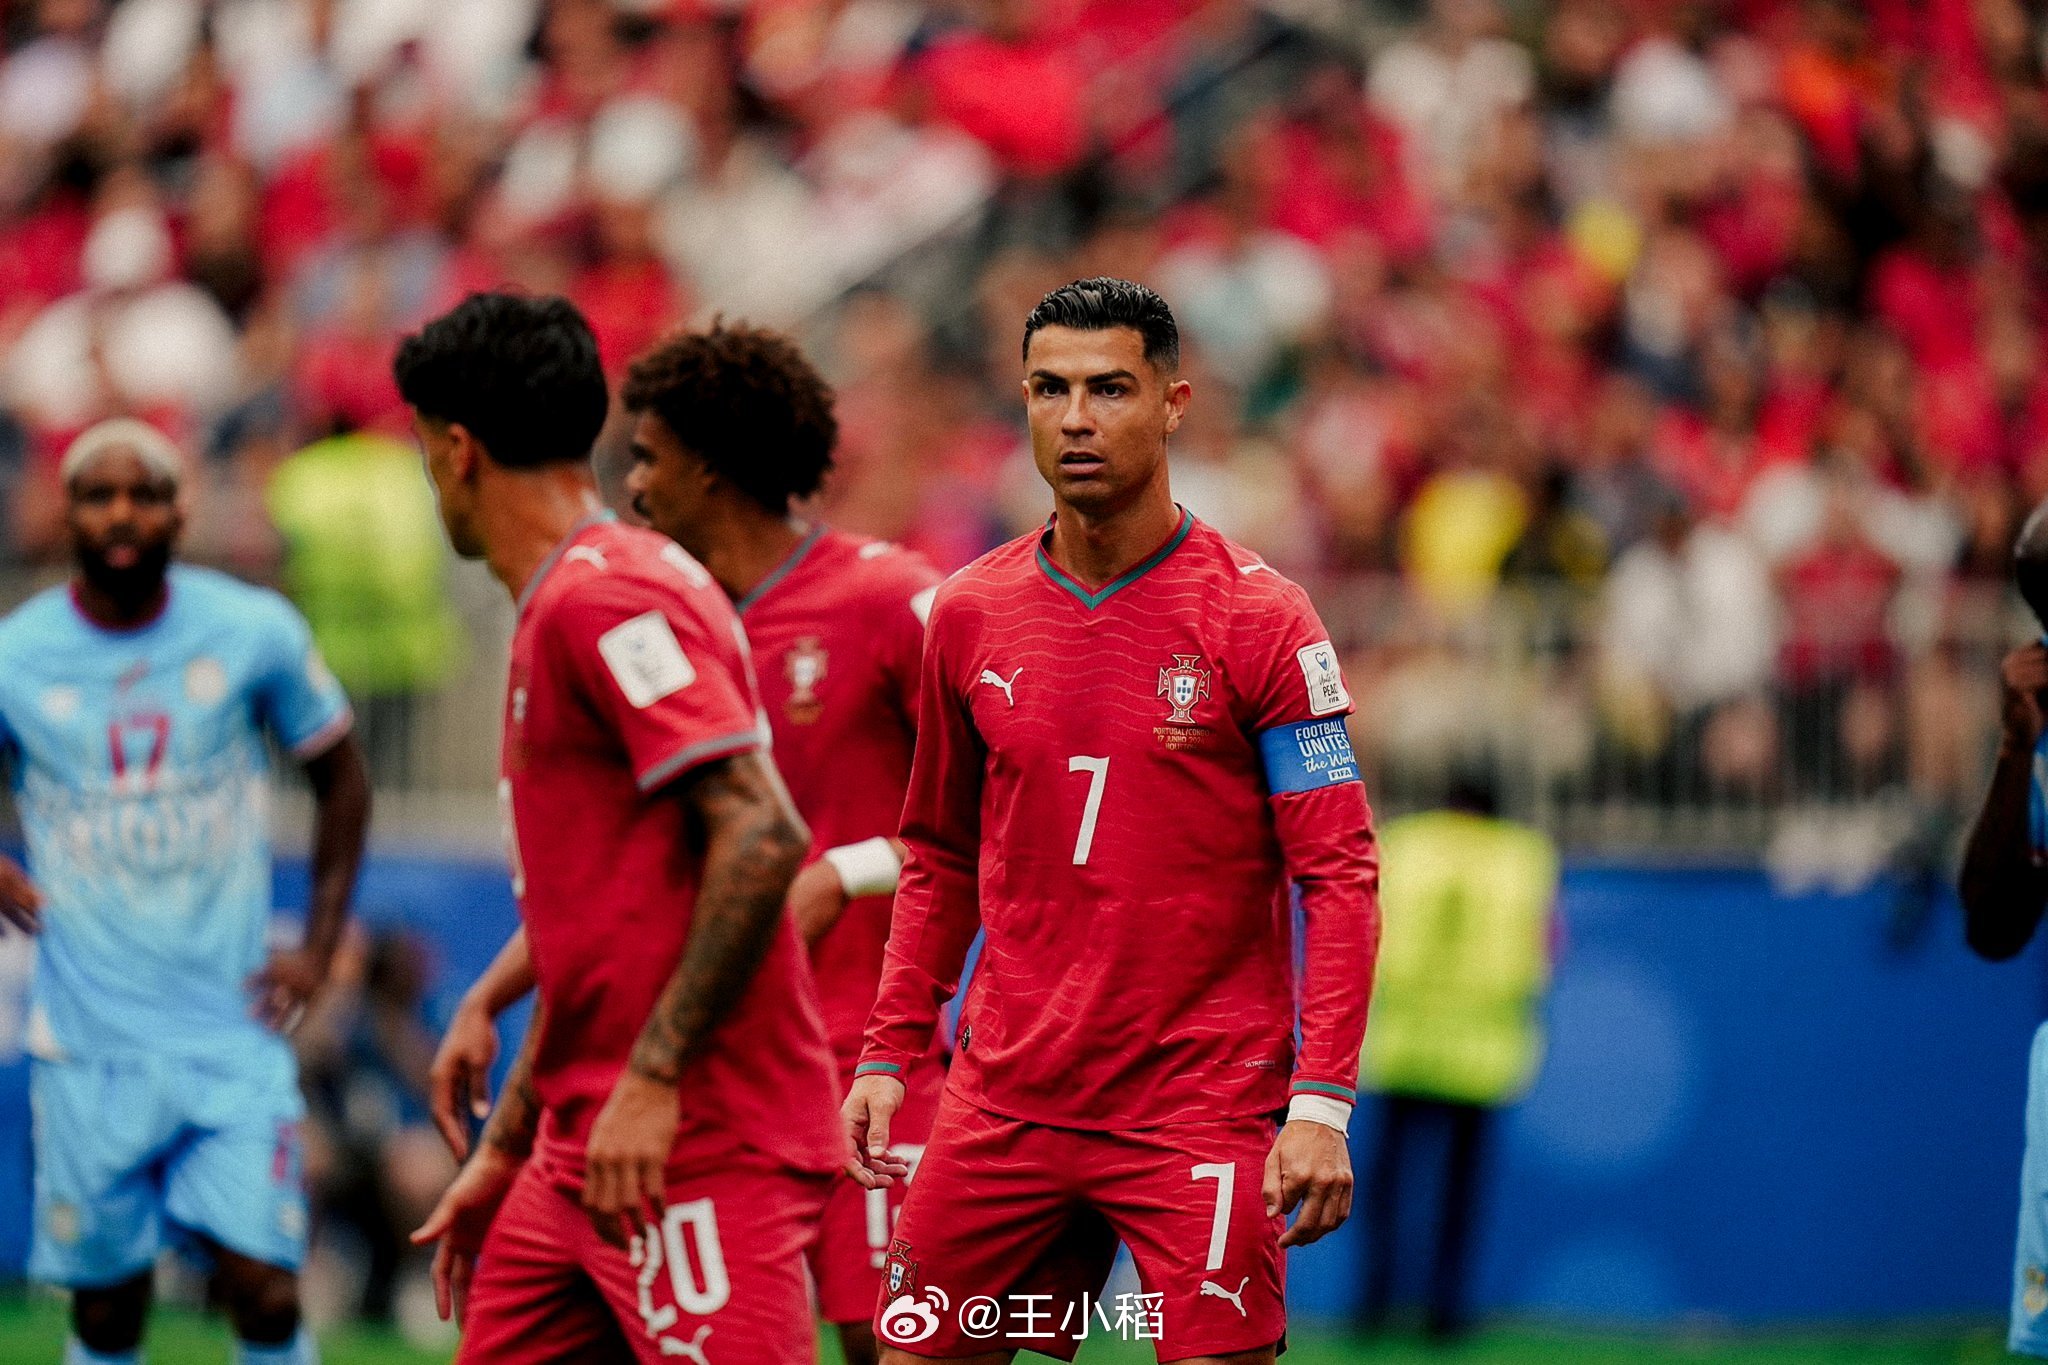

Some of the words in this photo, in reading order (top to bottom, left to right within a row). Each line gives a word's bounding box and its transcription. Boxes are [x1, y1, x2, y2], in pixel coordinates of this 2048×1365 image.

[1322, 683, 1338, 697] PEAC
[1295, 720, 1344, 741] FOOTBALL
[107, 713, 171, 791] 17
[1298, 733, 1350, 758] UNITES
[1302, 757, 1328, 773] the
[1327, 750, 1357, 767] World
[1330, 769, 1352, 779] FIFA
[1068, 755, 1110, 865] 7
[1191, 1162, 1235, 1270] 7
[629, 1197, 731, 1337] 20
